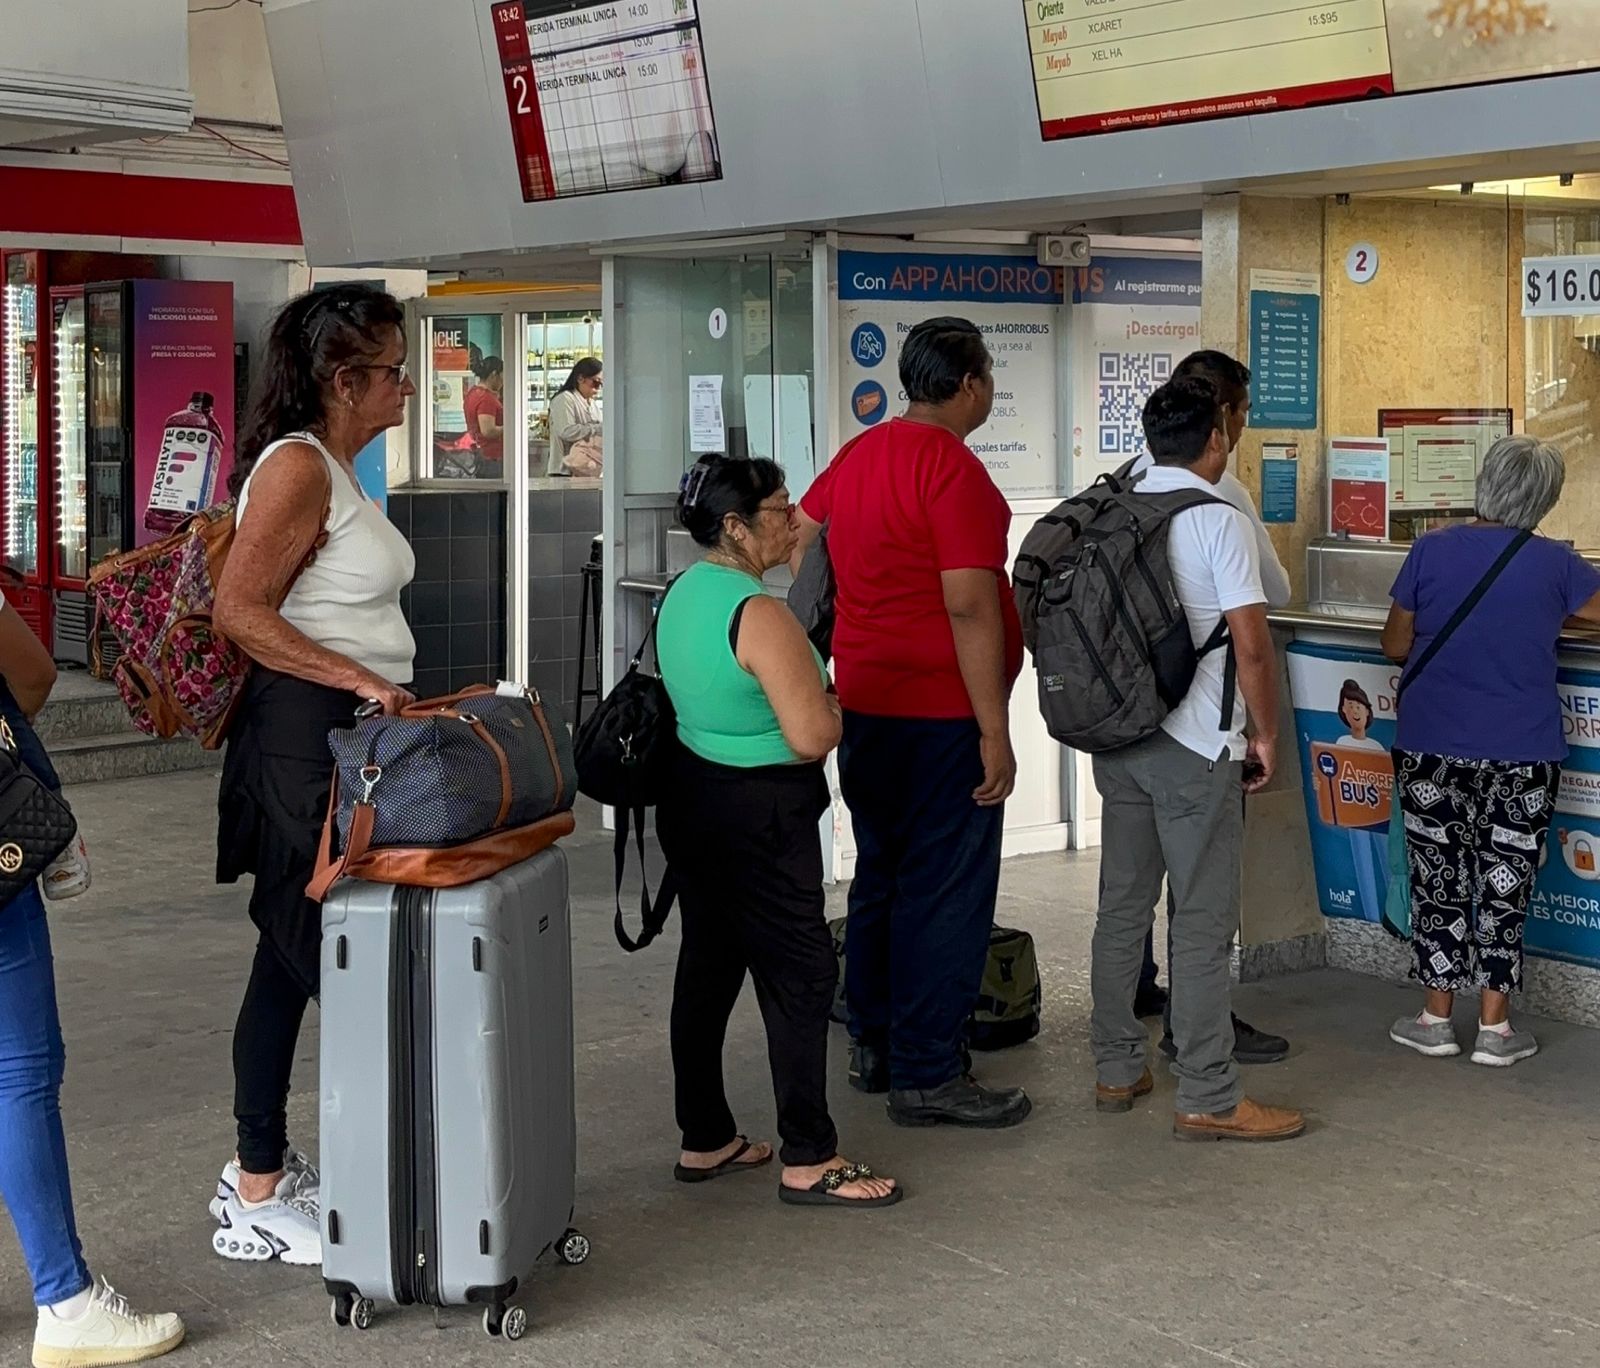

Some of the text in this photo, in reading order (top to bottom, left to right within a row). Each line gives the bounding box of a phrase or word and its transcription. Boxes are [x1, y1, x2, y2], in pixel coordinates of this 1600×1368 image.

[498, 7, 519, 23] 13:42
[527, 3, 648, 35] MERIDA TERMINAL UNICA 14:00
[1037, 2, 1064, 21] Oriente
[1042, 19, 1122, 46] Mayab XCARET
[1046, 53, 1071, 73] Mayab
[1092, 50, 1109, 61] XEL
[1110, 47, 1122, 58] HA
[536, 63, 658, 92] MERIDA TERMINAL UNICA 15:00
[513, 75, 531, 114] 2
[1356, 250, 1367, 271] 2
[853, 272, 886, 290] Con
[889, 265, 938, 291] APP
[1114, 280, 1202, 296] Al registrarme pu
[1527, 268, 1600, 307] $16.0
[715, 314, 720, 331] 1
[995, 323, 1050, 334] AHORROBUS
[997, 343, 1008, 353] ya
[1008, 343, 1024, 351] sea
[1000, 442, 1027, 451] tarifas
[148, 429, 175, 506] FLASHLYTE
[1329, 888, 1352, 904] hola
[1530, 890, 1600, 913] LA MEJOR
[1533, 905, 1550, 920] ES
[1554, 910, 1587, 927] CON
